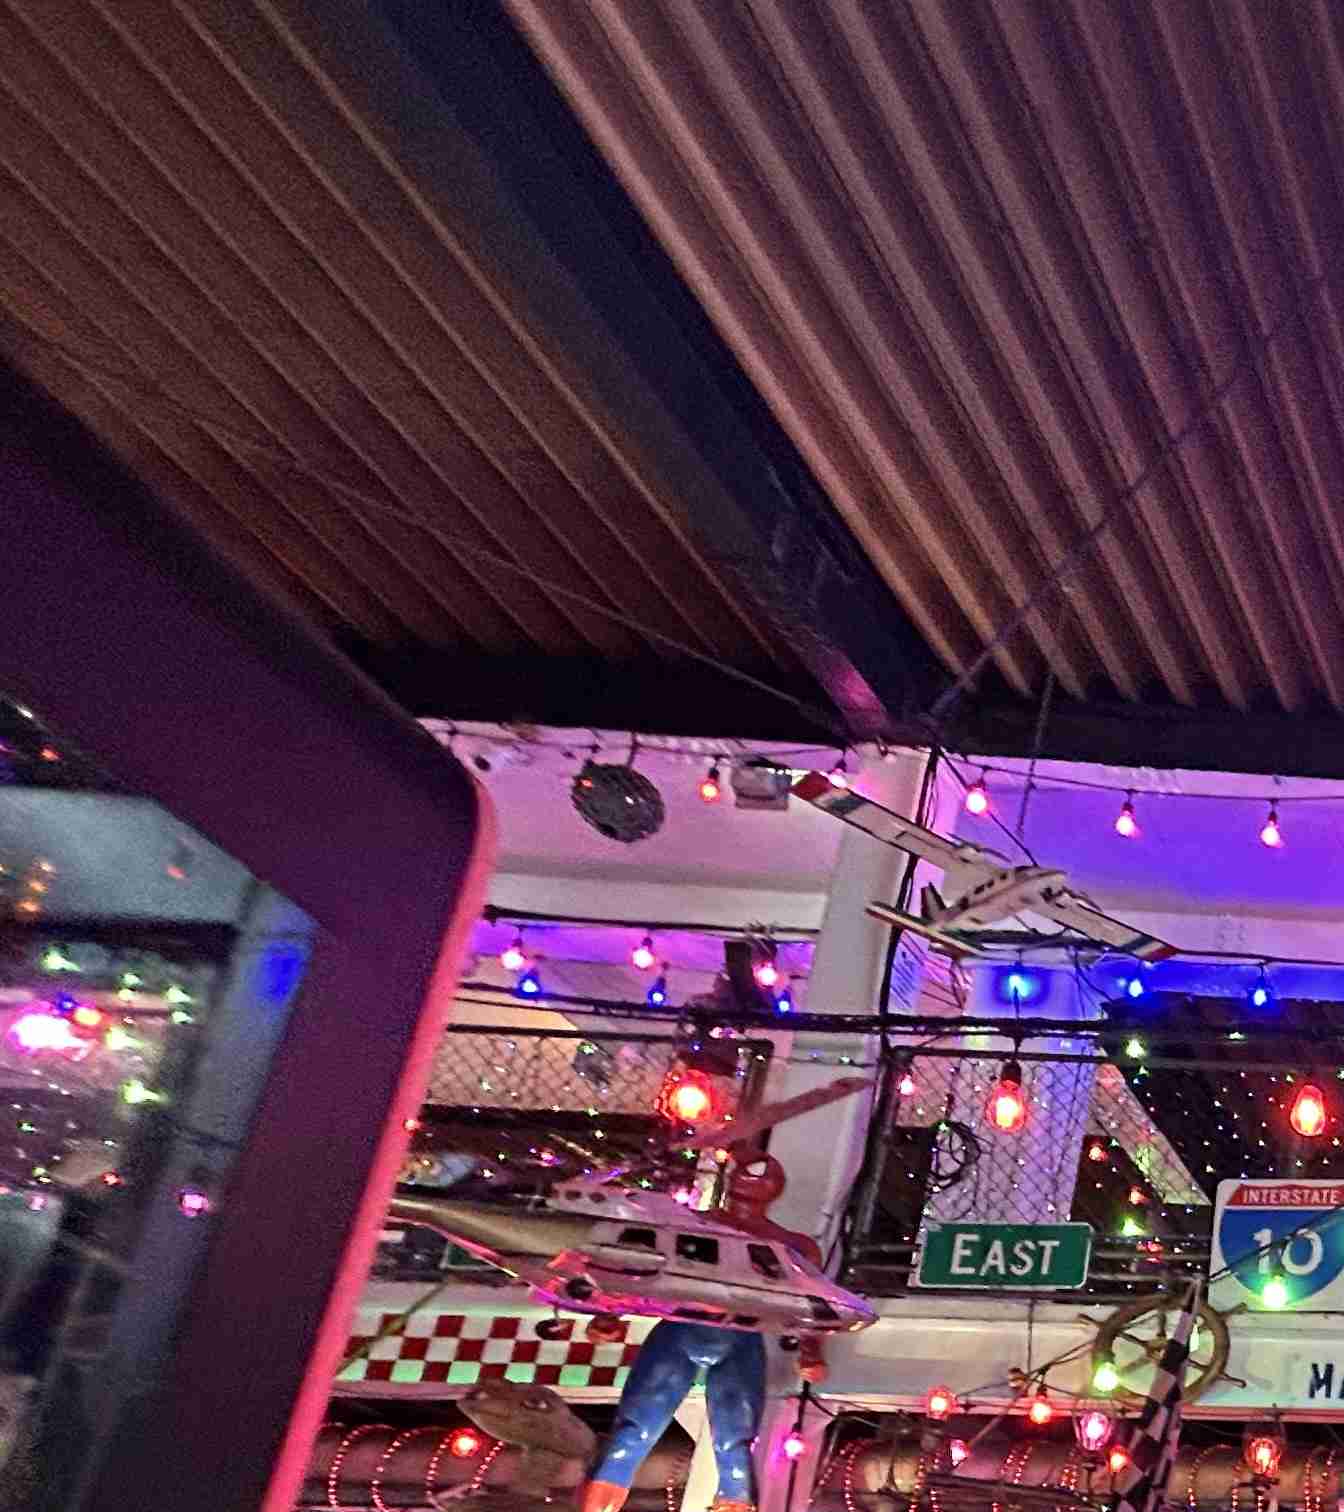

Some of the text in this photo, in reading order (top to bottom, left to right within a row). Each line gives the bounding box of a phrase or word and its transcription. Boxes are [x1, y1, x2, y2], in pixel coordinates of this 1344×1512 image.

[1242, 1188, 1340, 1205] INTERSTATE
[949, 1232, 1061, 1277] EAST
[1252, 1228, 1324, 1276] 10
